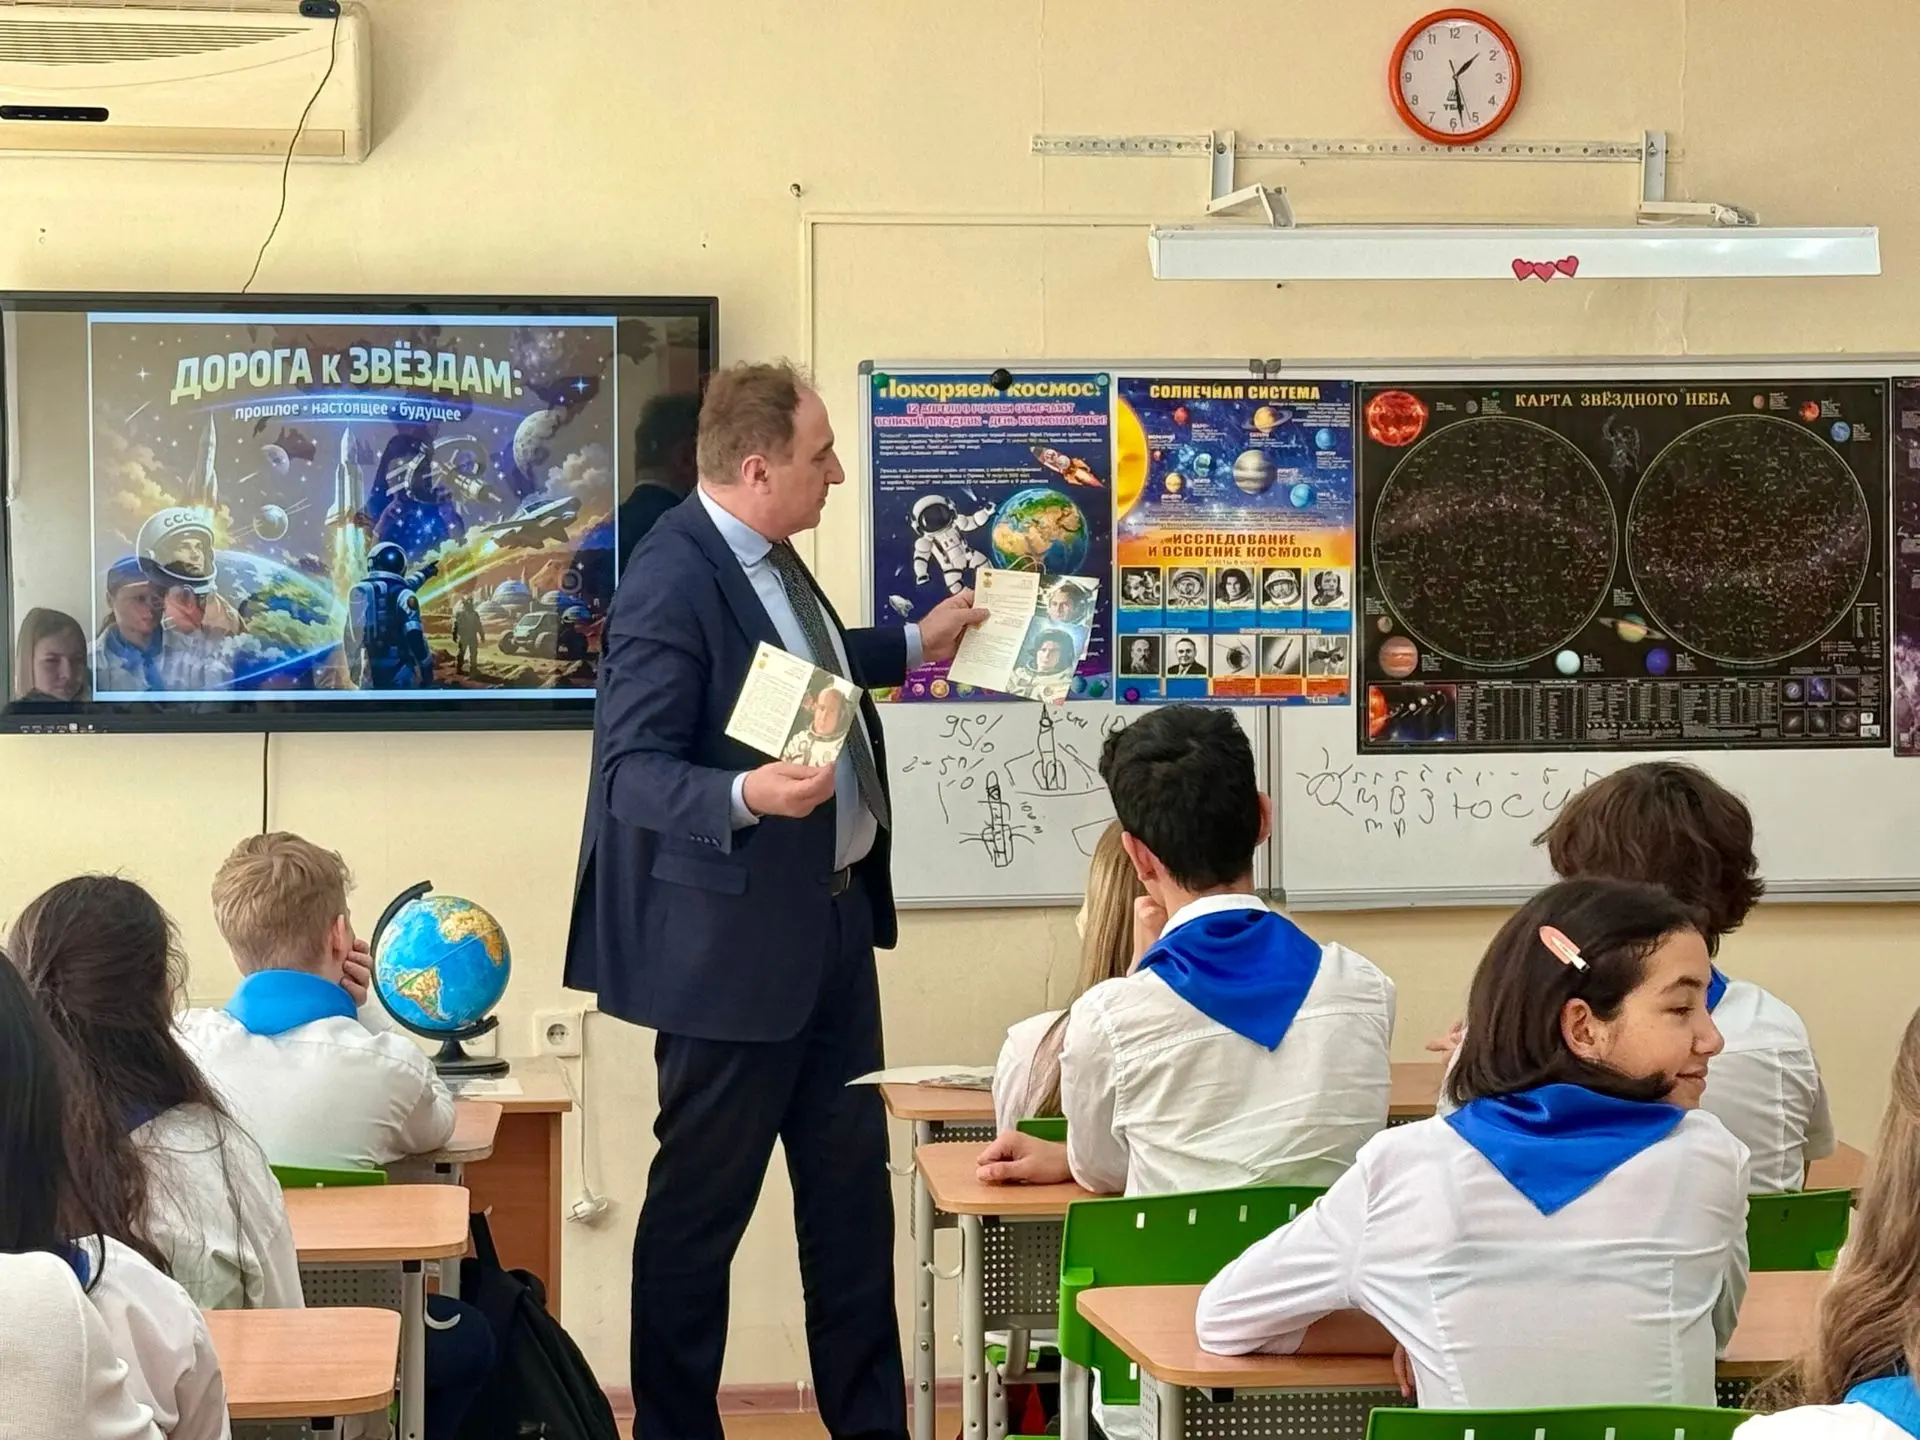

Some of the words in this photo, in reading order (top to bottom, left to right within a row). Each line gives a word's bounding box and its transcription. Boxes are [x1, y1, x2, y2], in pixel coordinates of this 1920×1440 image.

[1428, 33, 1436, 45] 11
[1449, 28, 1460, 39] 12
[1474, 33, 1479, 44] 1
[1412, 50, 1424, 61] 10
[1489, 50, 1497, 61] 2
[1405, 72, 1412, 83] 9
[1495, 73, 1503, 84] 3
[1411, 94, 1419, 105] 8
[1488, 95, 1496, 106] 4
[1428, 111, 1436, 122] 7
[1472, 111, 1479, 122] 5
[1449, 118, 1457, 129] 6
[170, 347, 313, 405] ДОРОГА
[348, 341, 523, 400] ЗВЁЗДАМ:
[879, 379, 1000, 402] Покоряем
[1150, 384, 1244, 399] СОЛНЕЧНАЯ
[1248, 385, 1321, 399] СИСТЕМА
[1515, 394, 1573, 407] КАРТА
[1580, 391, 1678, 409] ЗВЁЗДНОГО
[1685, 392, 1731, 406] НЕБА
[234, 404, 300, 422] прошлое
[311, 401, 388, 418] настоящее
[399, 404, 462, 423] будущее
[164, 513, 203, 528] ССС
[1173, 533, 1296, 546] ИССЛЕДОВАНИЕ
[1149, 546, 1157, 557] И
[1162, 546, 1243, 557] ОСВОЕНИЕ
[1246, 546, 1322, 558] КОСМОСА
